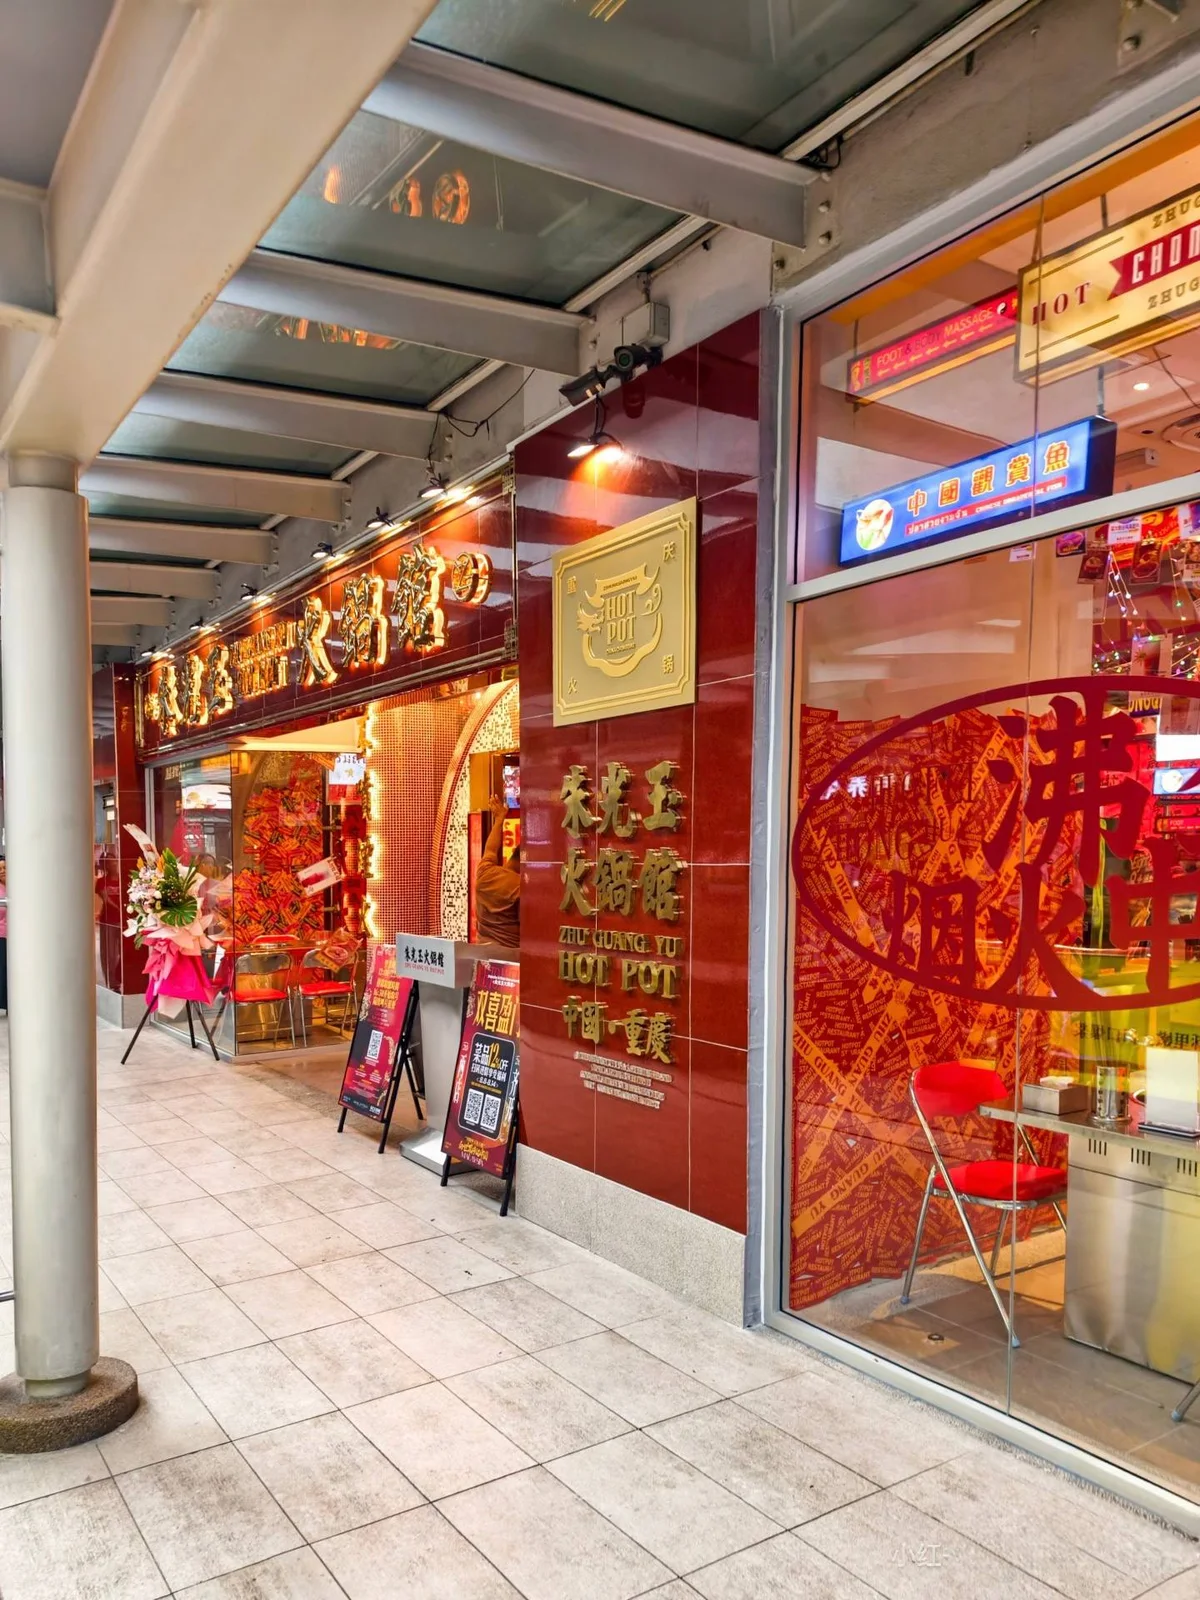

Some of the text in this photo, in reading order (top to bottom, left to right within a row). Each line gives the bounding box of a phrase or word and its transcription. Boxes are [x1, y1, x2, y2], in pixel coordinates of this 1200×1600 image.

[1032, 282, 1092, 325] HOT
[876, 347, 904, 367] FOOT
[905, 343, 911, 354] &
[943, 306, 994, 337] MASSAGE
[907, 440, 1070, 516] 中國觀賞魚
[662, 540, 677, 563] 庆
[297, 543, 446, 686] 火鍋館
[605, 590, 637, 621] HOT
[607, 615, 637, 645] POT
[568, 677, 578, 695] 火
[561, 760, 684, 838] 朱光玉
[559, 846, 686, 921] 火鍋館
[559, 926, 681, 958] ZHU GUANG YU
[558, 950, 681, 998] HOT POT
[816, 989, 850, 998] RESTAURANT
[827, 1028, 861, 1038] RESTAURANT
[834, 1022, 855, 1031] HOTPOT
[814, 1056, 847, 1096] GUANG
[850, 1095, 864, 1113] YU
